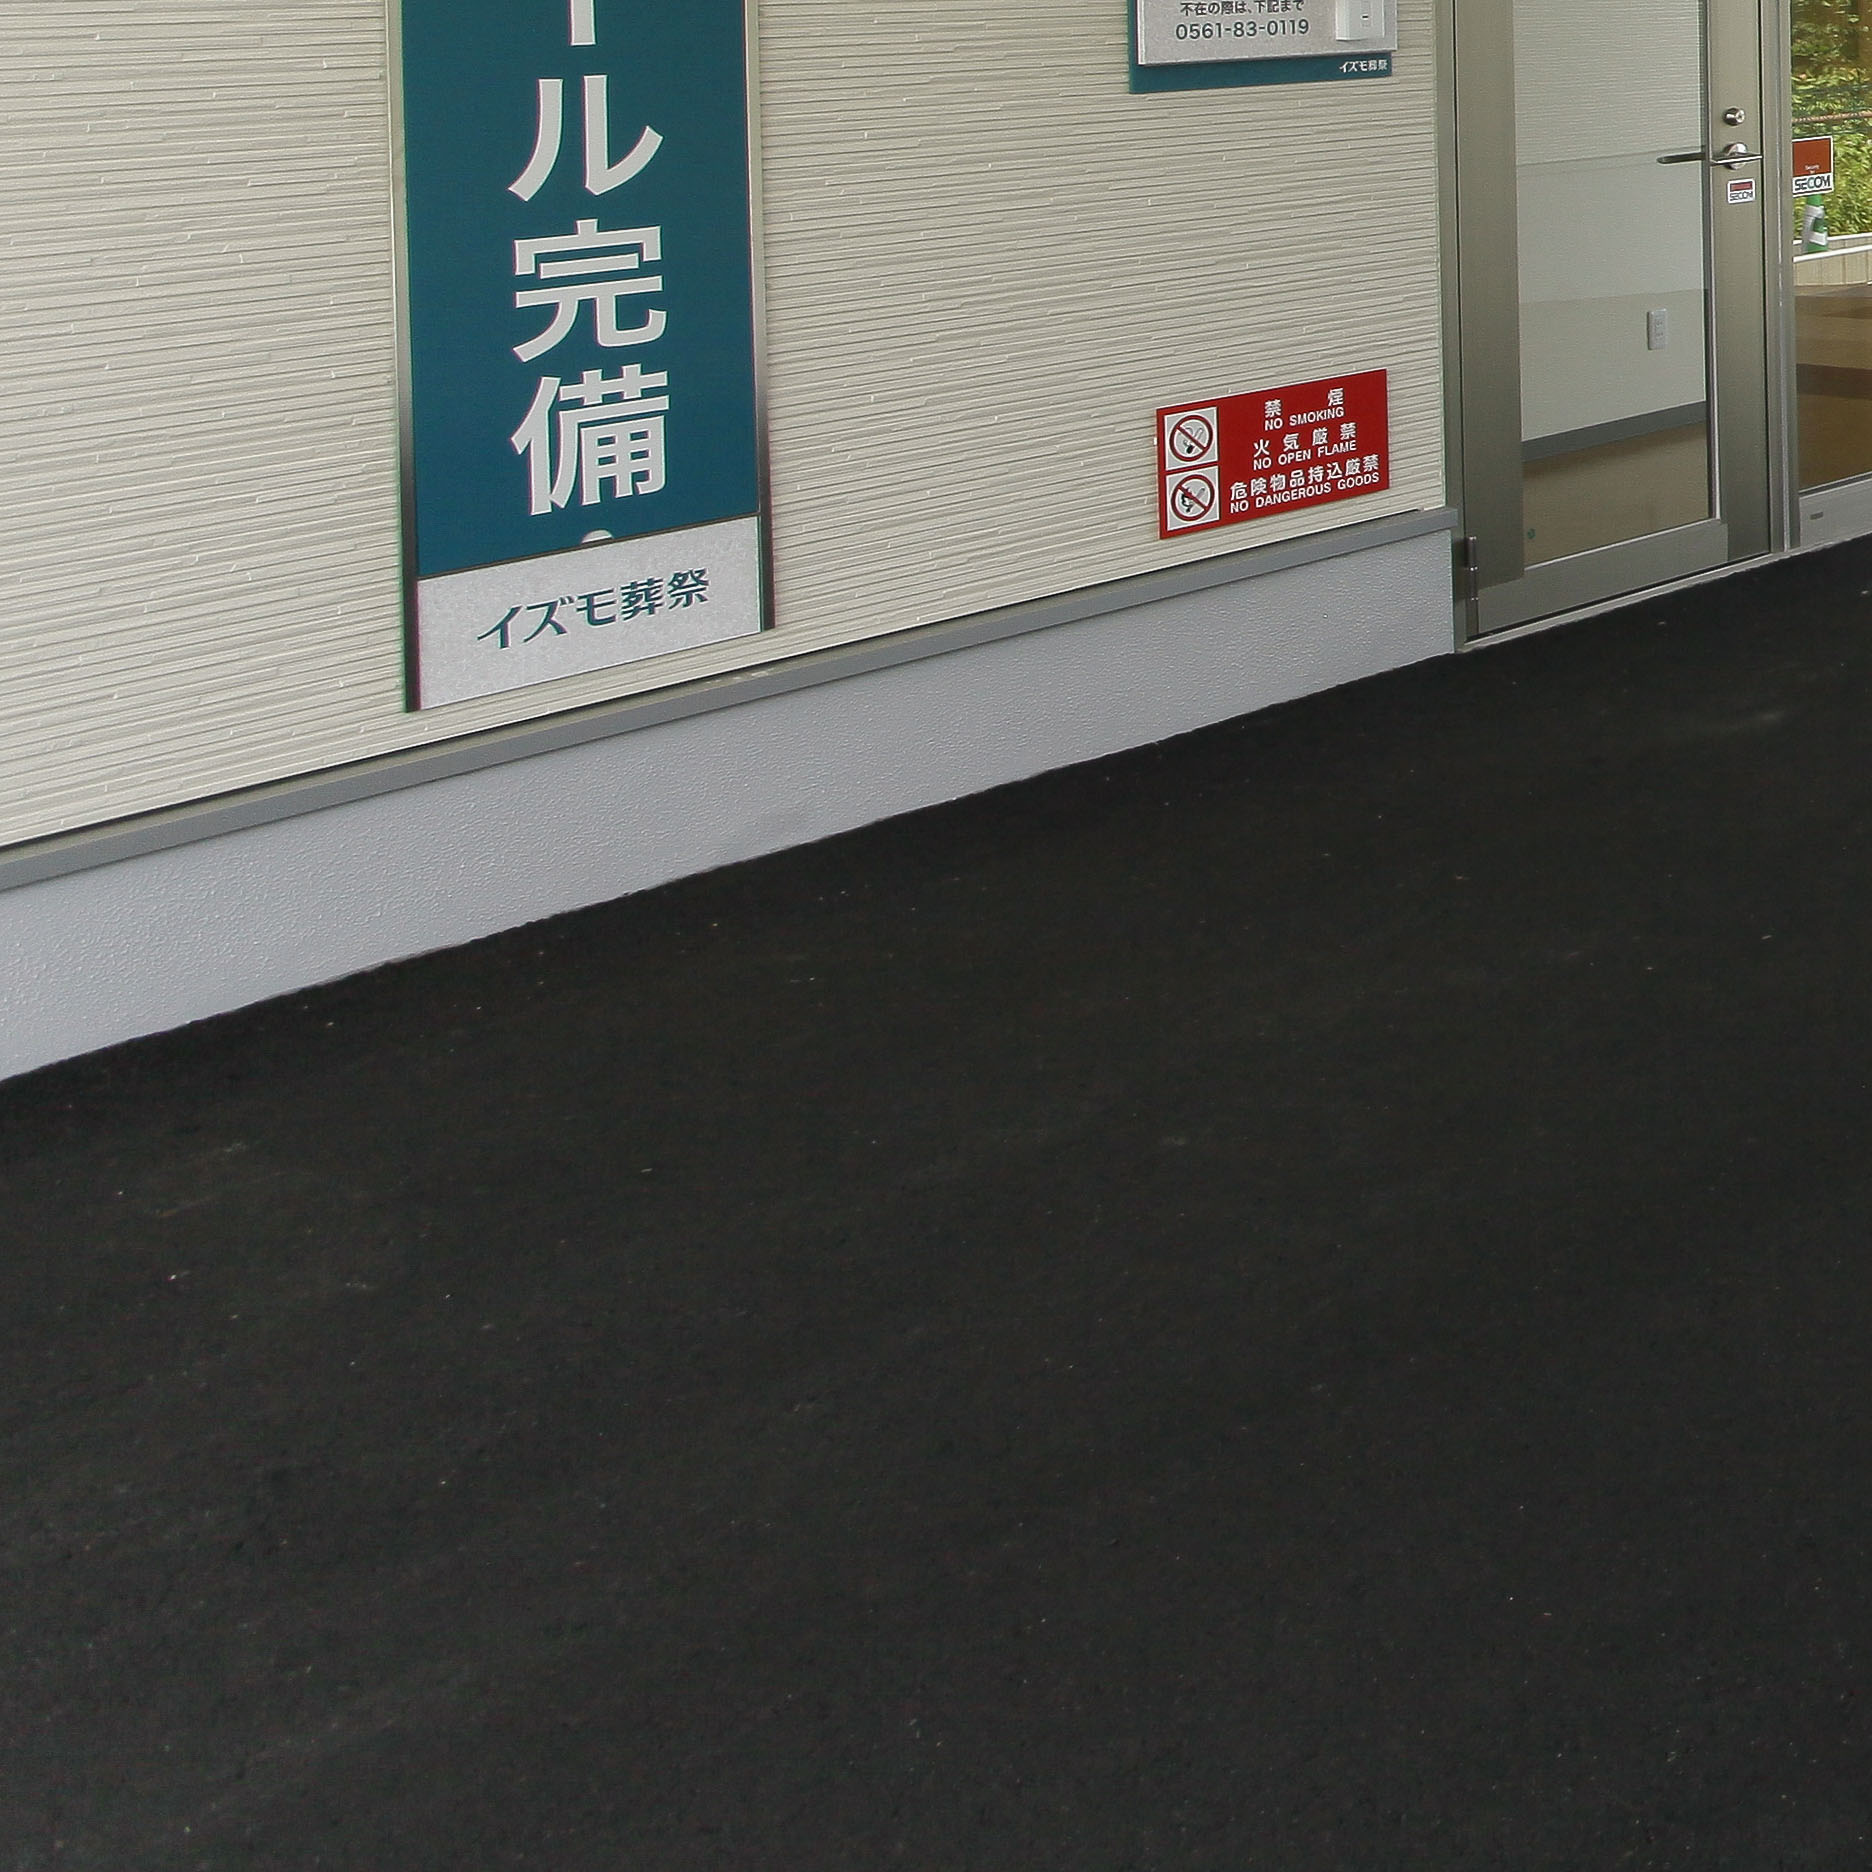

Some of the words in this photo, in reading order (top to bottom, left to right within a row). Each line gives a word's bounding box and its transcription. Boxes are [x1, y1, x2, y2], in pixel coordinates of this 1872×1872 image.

[1180, 0, 1305, 16] 不在の際は、下記まで
[1176, 19, 1309, 40] 0561-83-0119
[1795, 175, 1830, 191] SECOM
[1265, 388, 1344, 418] 禁煙
[1265, 418, 1283, 431] NO
[1290, 407, 1344, 426] SMOKING
[1253, 422, 1356, 457] 火気厳禁
[1253, 457, 1272, 470] NO
[1278, 449, 1311, 465] OPEN
[1317, 440, 1357, 457] FLAME
[1230, 454, 1379, 500] 危険物品持込厳禁
[1230, 500, 1249, 513] NO
[1255, 482, 1331, 508] DANGEROUS
[1338, 472, 1379, 490] GOODS
[477, 567, 709, 648] イズモ葬祭
